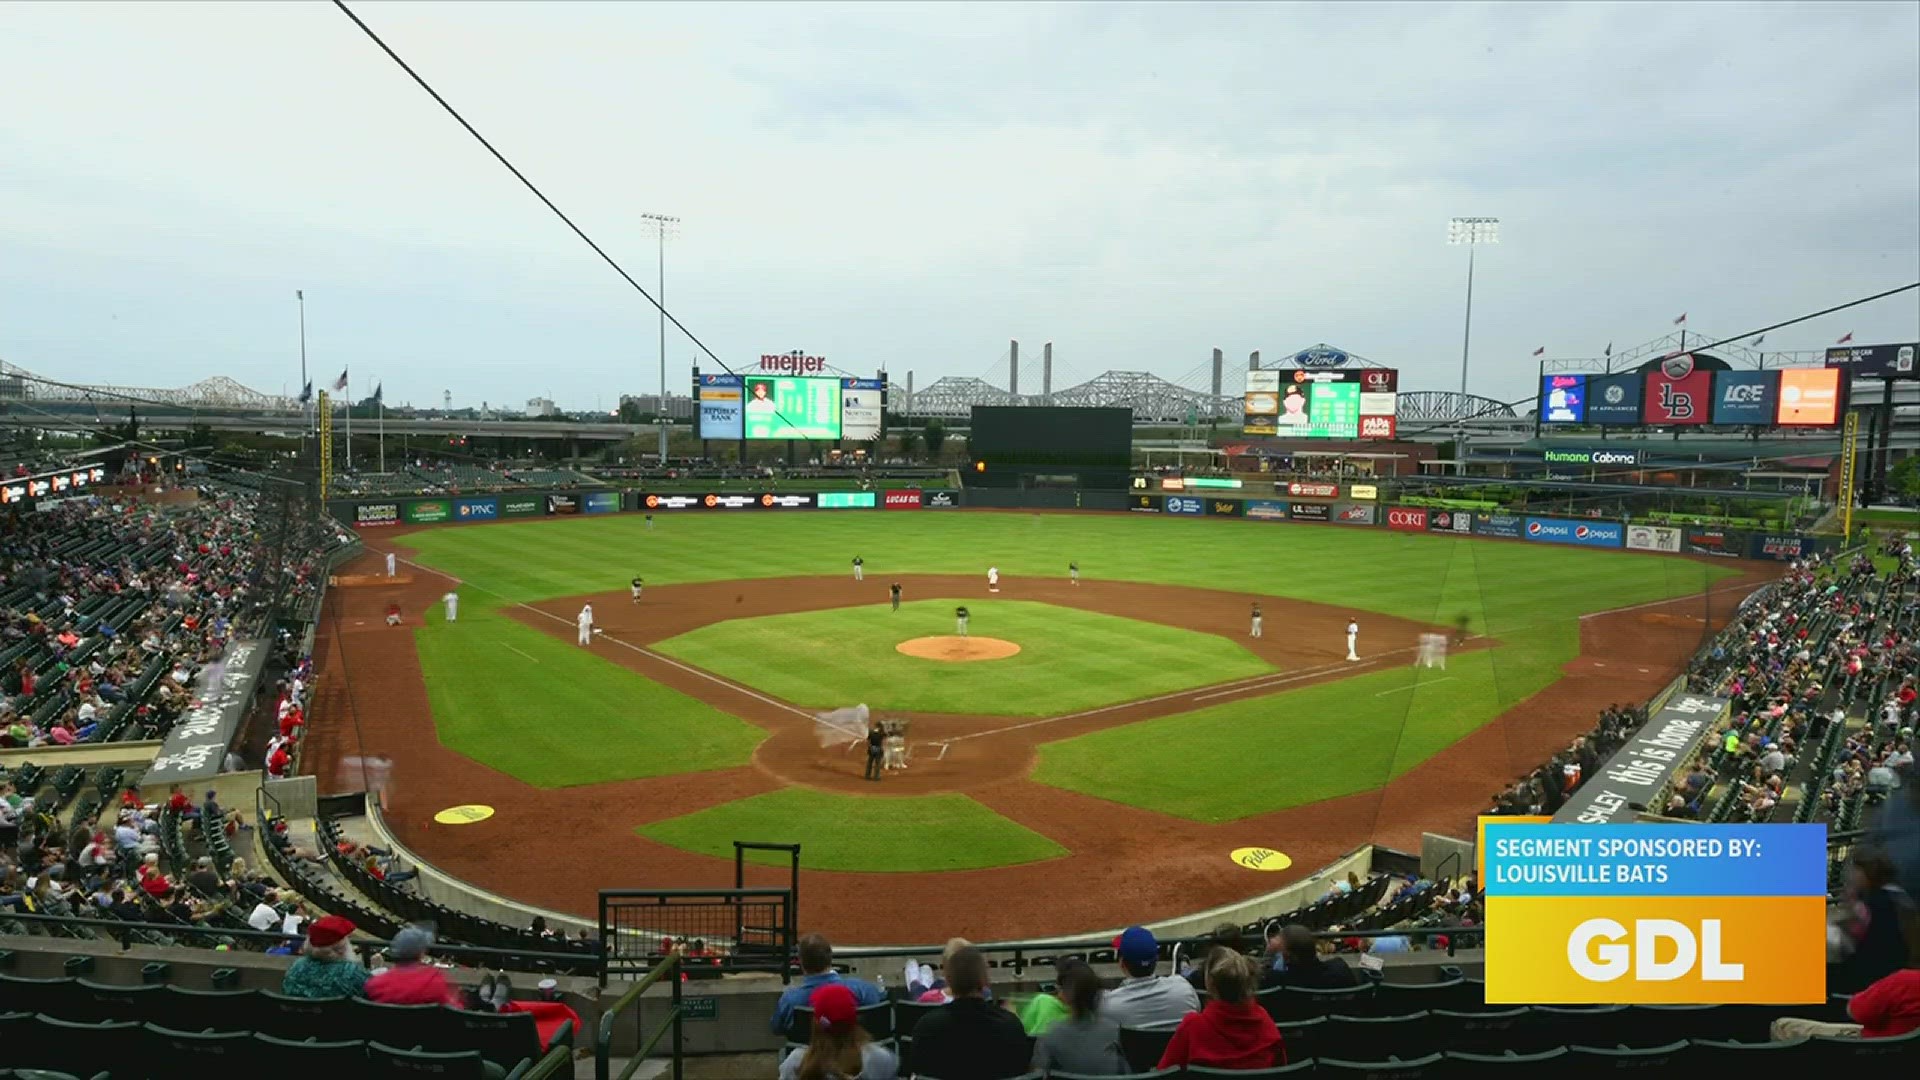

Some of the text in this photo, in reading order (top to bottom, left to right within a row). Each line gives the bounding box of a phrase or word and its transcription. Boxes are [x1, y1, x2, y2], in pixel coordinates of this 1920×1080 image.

[761, 350, 825, 376] meijer
[1304, 351, 1337, 366] Ford
[704, 407, 738, 415] REPUBLIC
[1545, 451, 1634, 464] Humana Cabana
[358, 505, 397, 513] BUMPER
[471, 504, 494, 514] PNC
[358, 513, 397, 521] BUMPER
[1389, 511, 1426, 526] CORT
[1541, 526, 1568, 536] pepsi
[1590, 529, 1617, 540] pepsi
[1765, 537, 1801, 546] MAJOR
[1629, 748, 1676, 761] is
[1606, 757, 1666, 785] this
[1577, 790, 1627, 824] SHLEY
